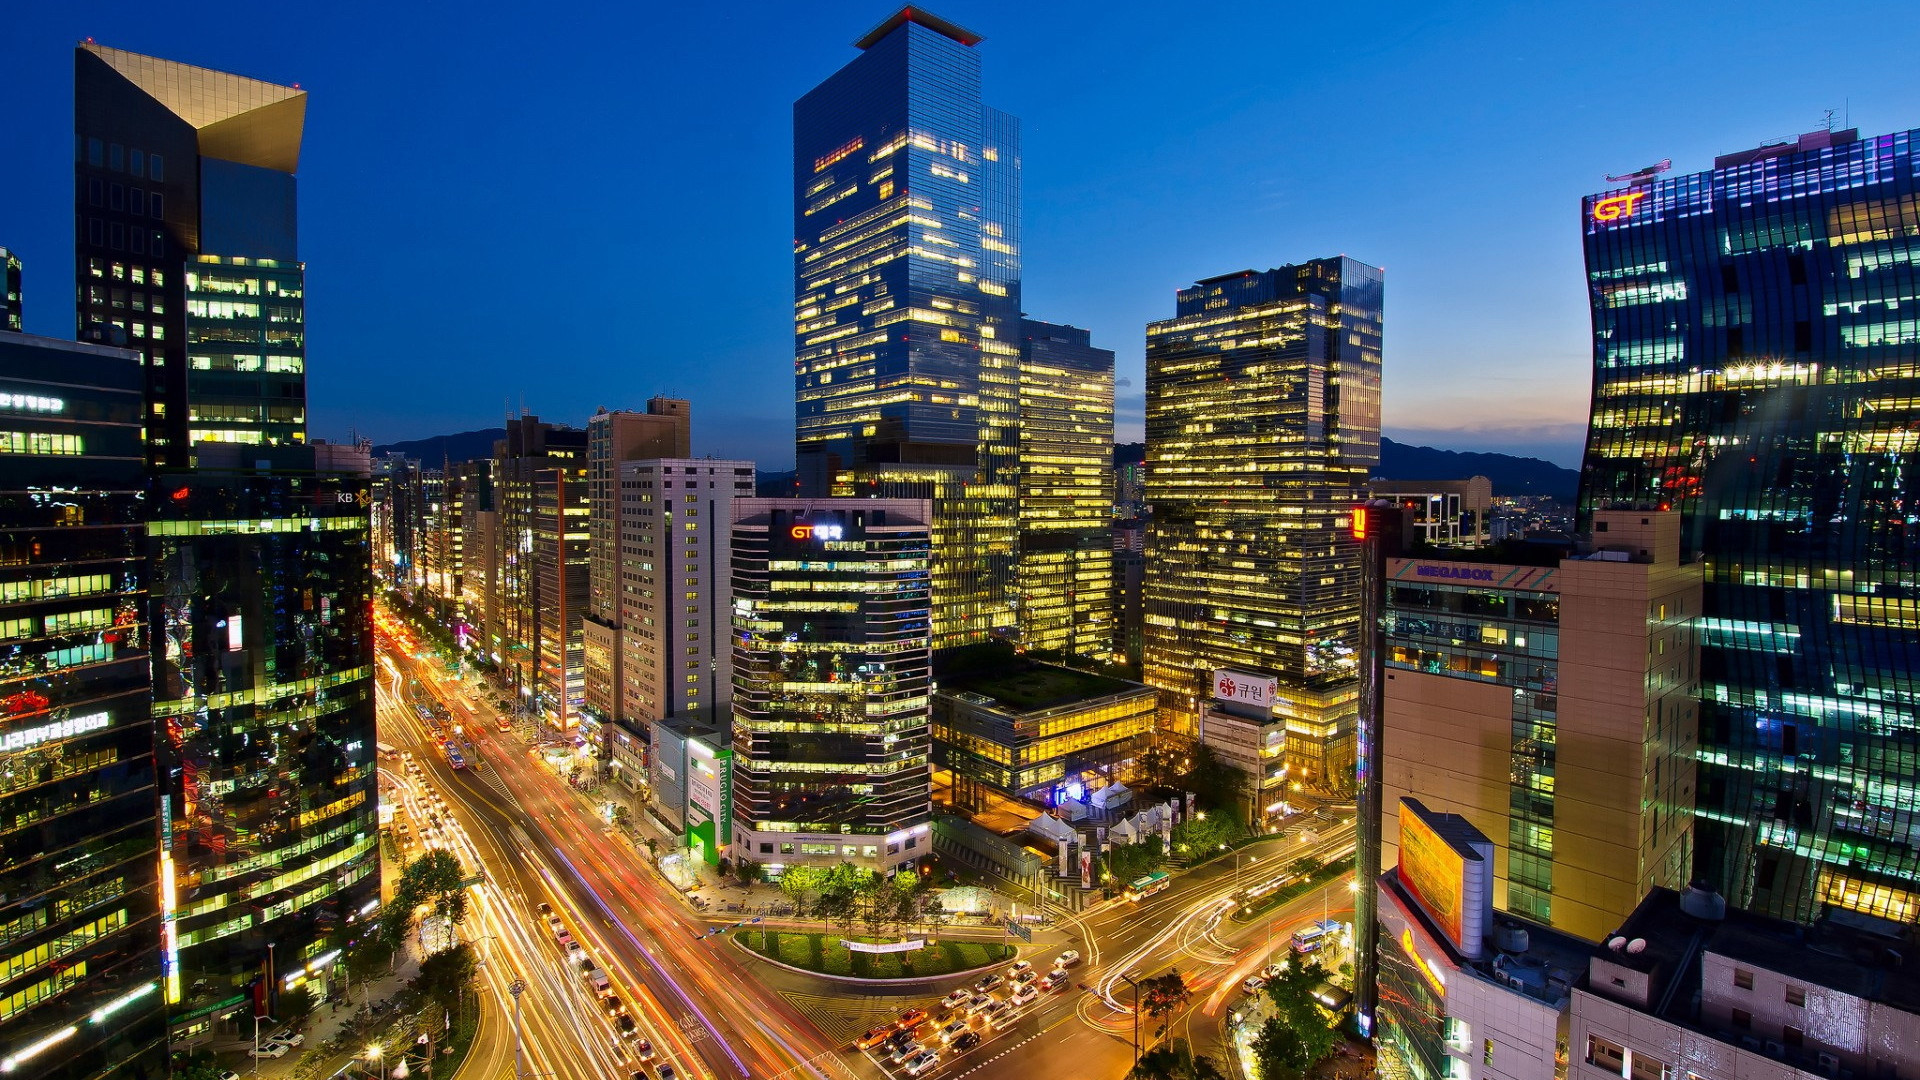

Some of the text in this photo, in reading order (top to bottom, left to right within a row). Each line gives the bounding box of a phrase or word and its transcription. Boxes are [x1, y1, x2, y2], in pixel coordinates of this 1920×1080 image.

[1594, 192, 1644, 220] GT
[337, 492, 353, 503] KB
[1417, 565, 1493, 580] MEGABOX
[1239, 683, 1262, 701] 큐원
[720, 757, 728, 801] PRUGIO
